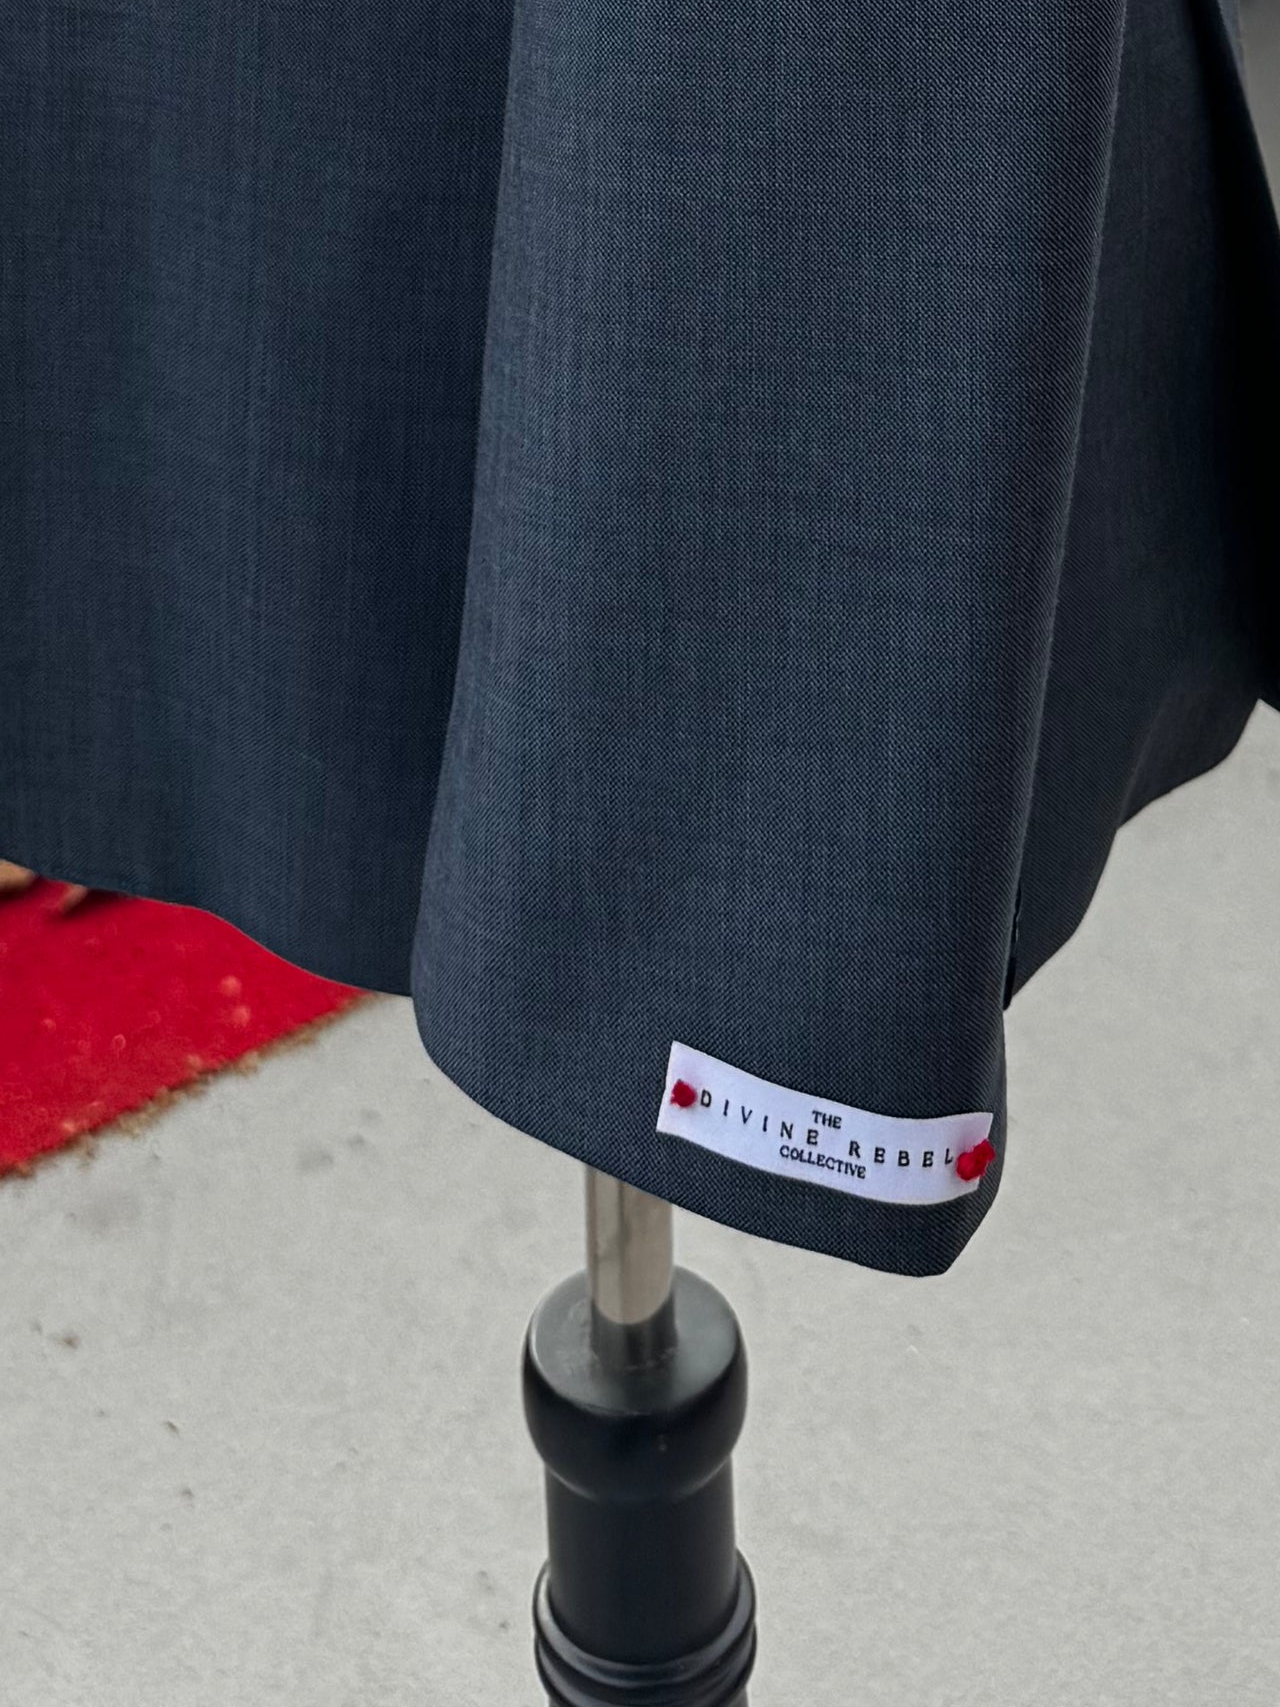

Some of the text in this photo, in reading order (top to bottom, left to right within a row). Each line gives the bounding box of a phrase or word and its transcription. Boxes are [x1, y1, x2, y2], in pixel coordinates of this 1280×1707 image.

[700, 1089, 954, 1168] DIVINE REBEL
[812, 1109, 842, 1130] THE
[779, 1144, 867, 1180] COLLECTIVE
